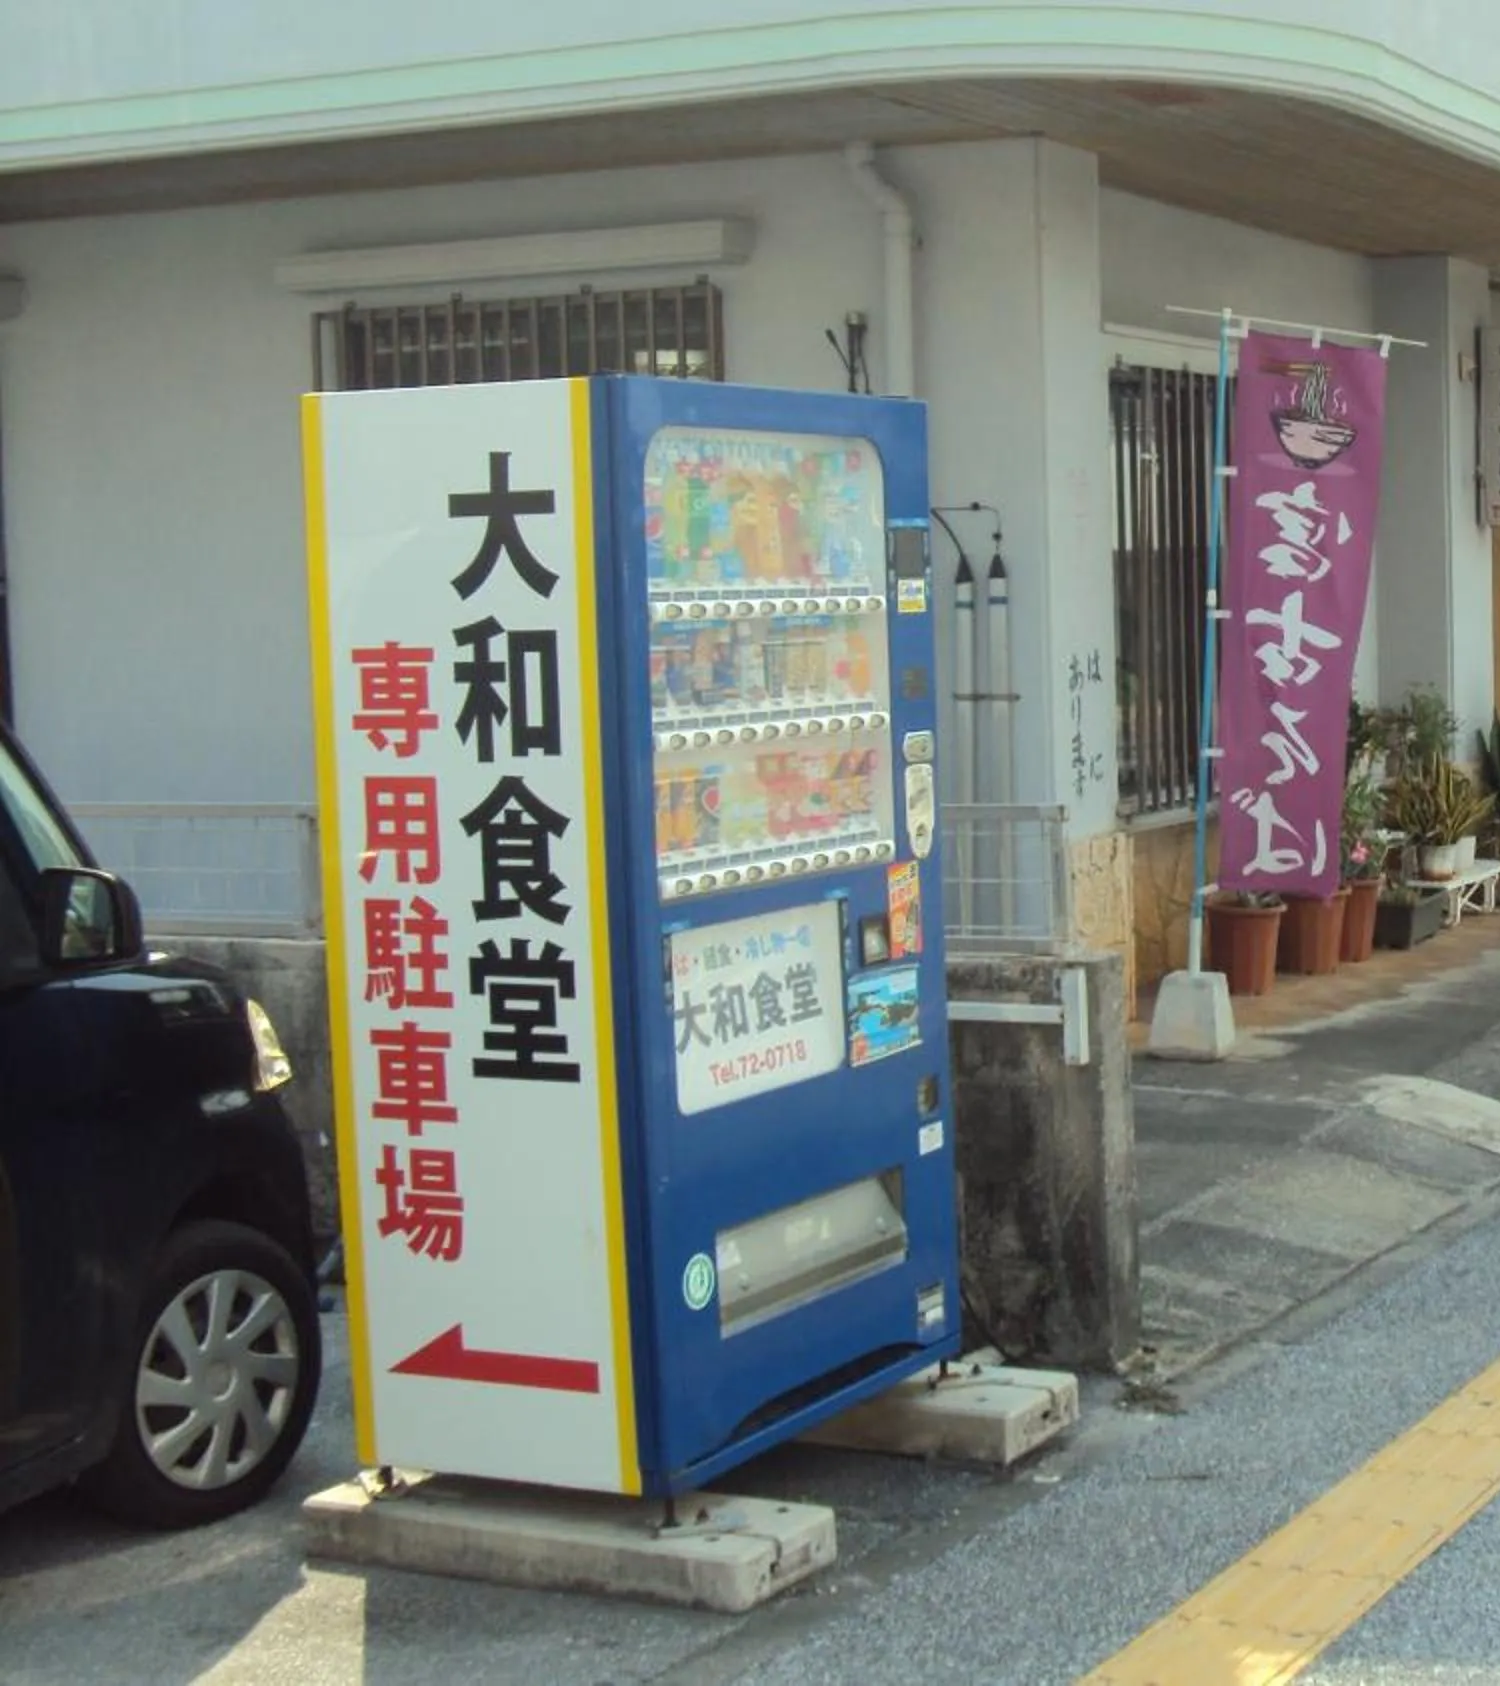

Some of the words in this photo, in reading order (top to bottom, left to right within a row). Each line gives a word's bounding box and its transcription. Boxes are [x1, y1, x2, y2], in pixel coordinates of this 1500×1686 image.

[447, 451, 581, 1083] 大和食堂
[351, 641, 464, 1262] 専用駐車場
[674, 962, 824, 1055] 大和食堂
[709, 1039, 808, 1087] Tel.72-0718
